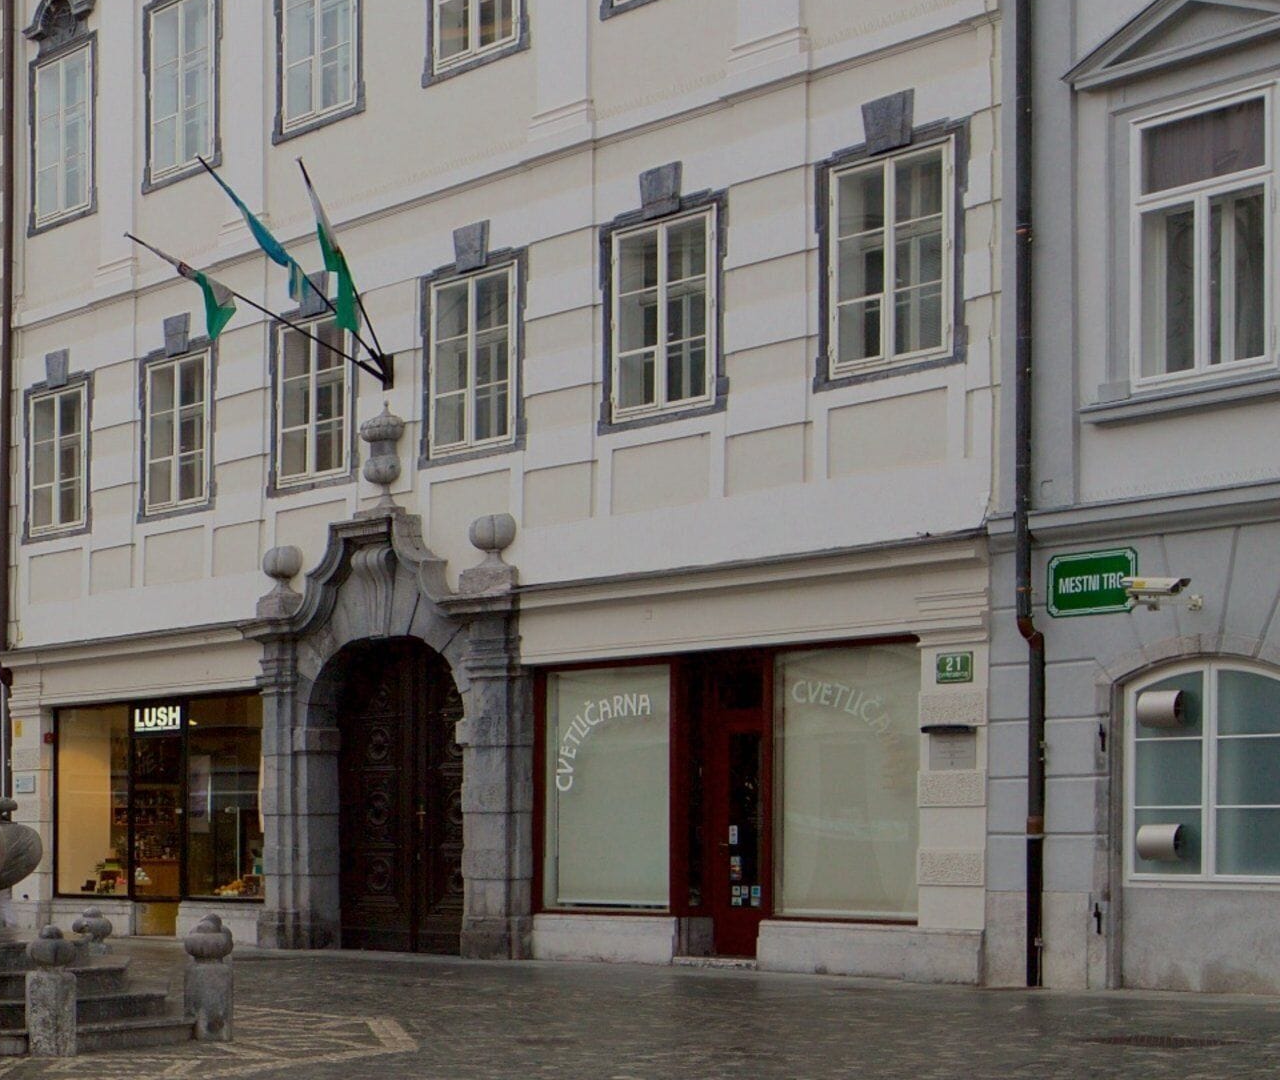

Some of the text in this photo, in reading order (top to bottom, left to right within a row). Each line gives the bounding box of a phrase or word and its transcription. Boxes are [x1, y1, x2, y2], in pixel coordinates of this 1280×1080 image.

[1059, 573, 1100, 594] MESTNI
[946, 656, 961, 671] 21
[134, 705, 181, 727] LUSH
[555, 693, 651, 791] CVETLIČARNA
